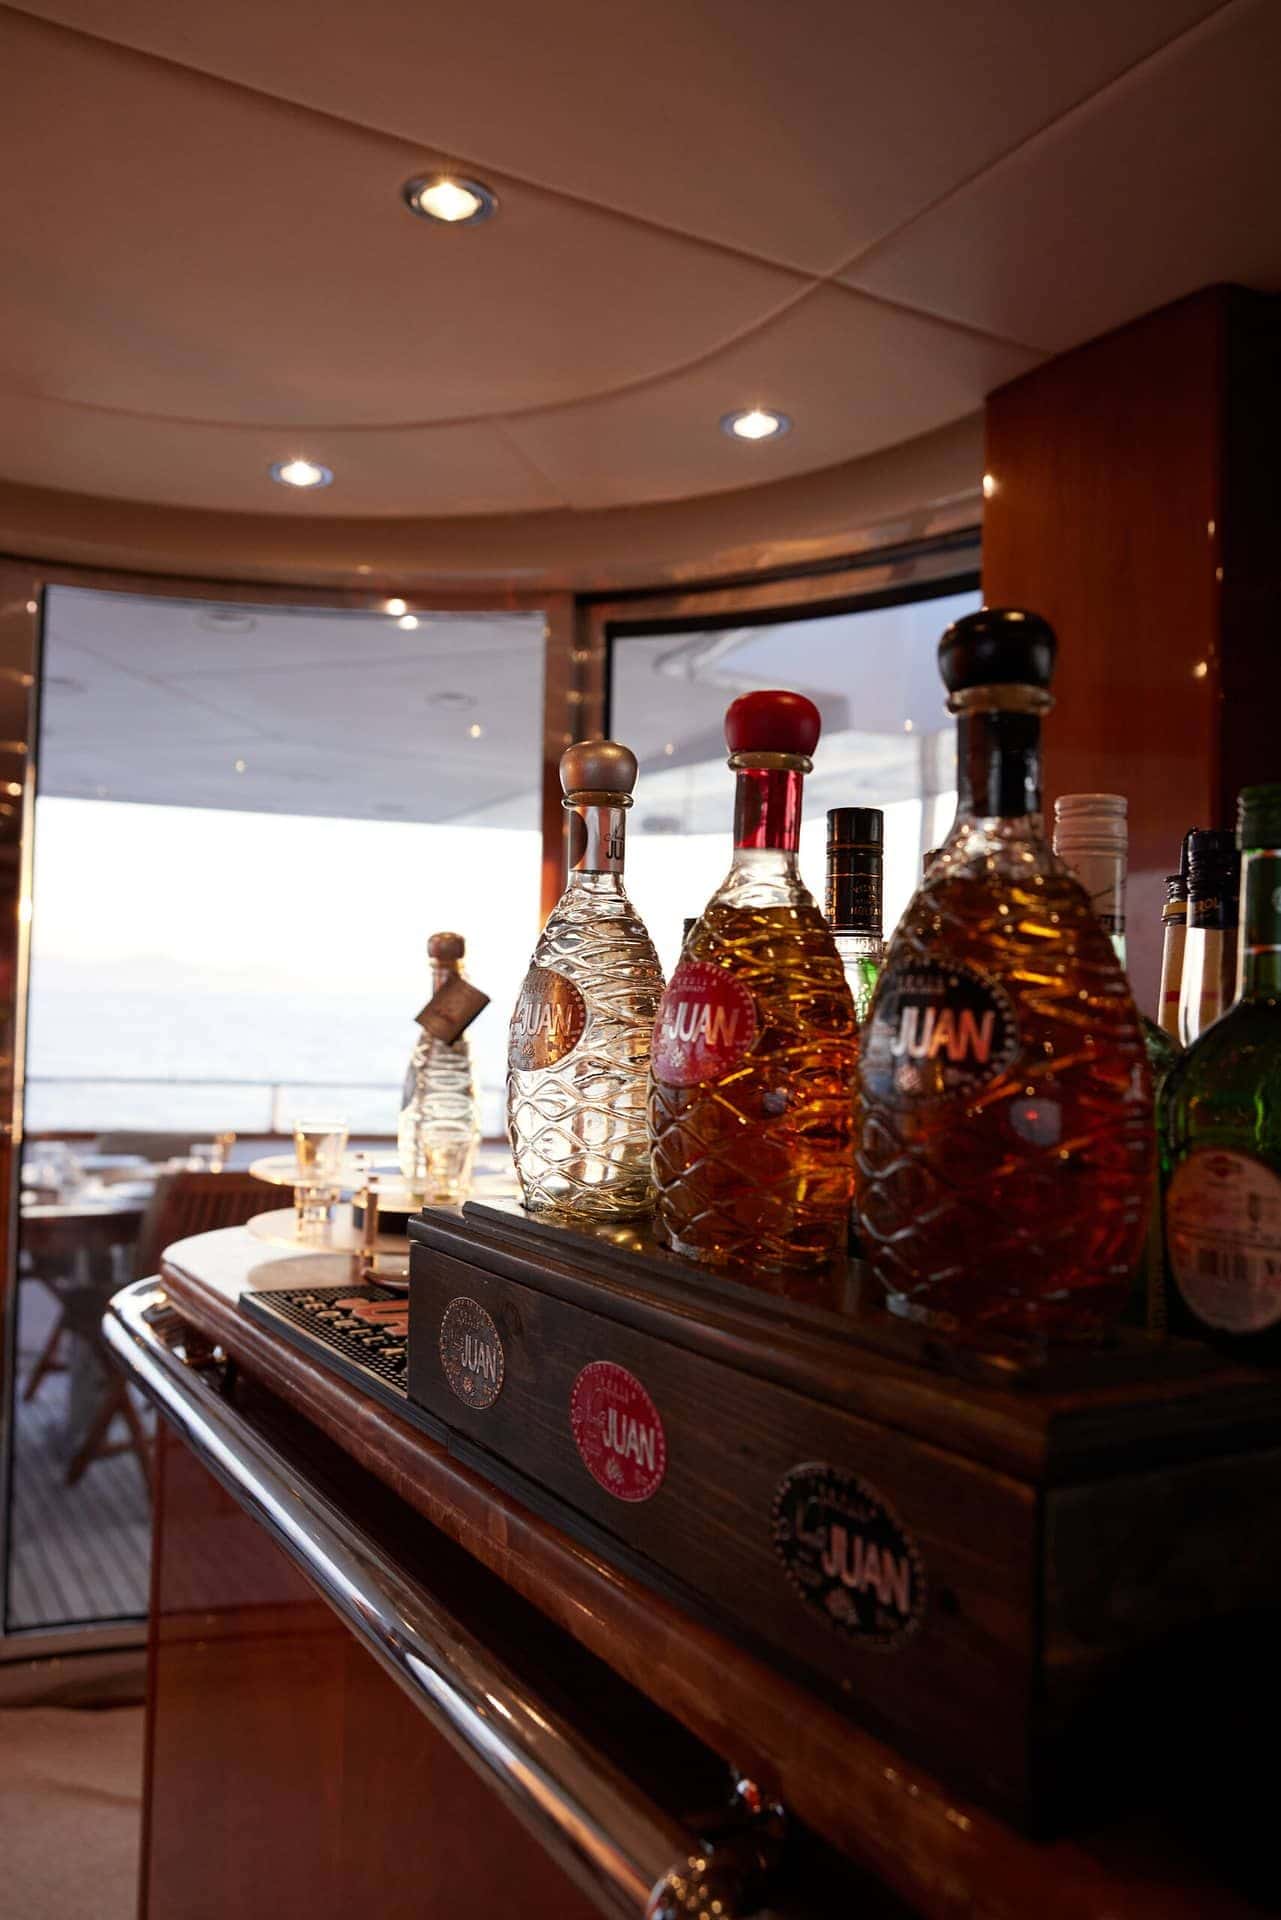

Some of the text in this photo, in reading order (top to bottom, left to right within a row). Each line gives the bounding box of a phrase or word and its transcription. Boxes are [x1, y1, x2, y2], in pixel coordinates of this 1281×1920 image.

[520, 1003, 574, 1038] JUAN
[661, 1001, 740, 1047] JUAN
[888, 1005, 996, 1065] JUAN
[461, 1334, 497, 1384] JUAN
[601, 1406, 656, 1473] JUAN
[820, 1522, 912, 1615] JUAN
